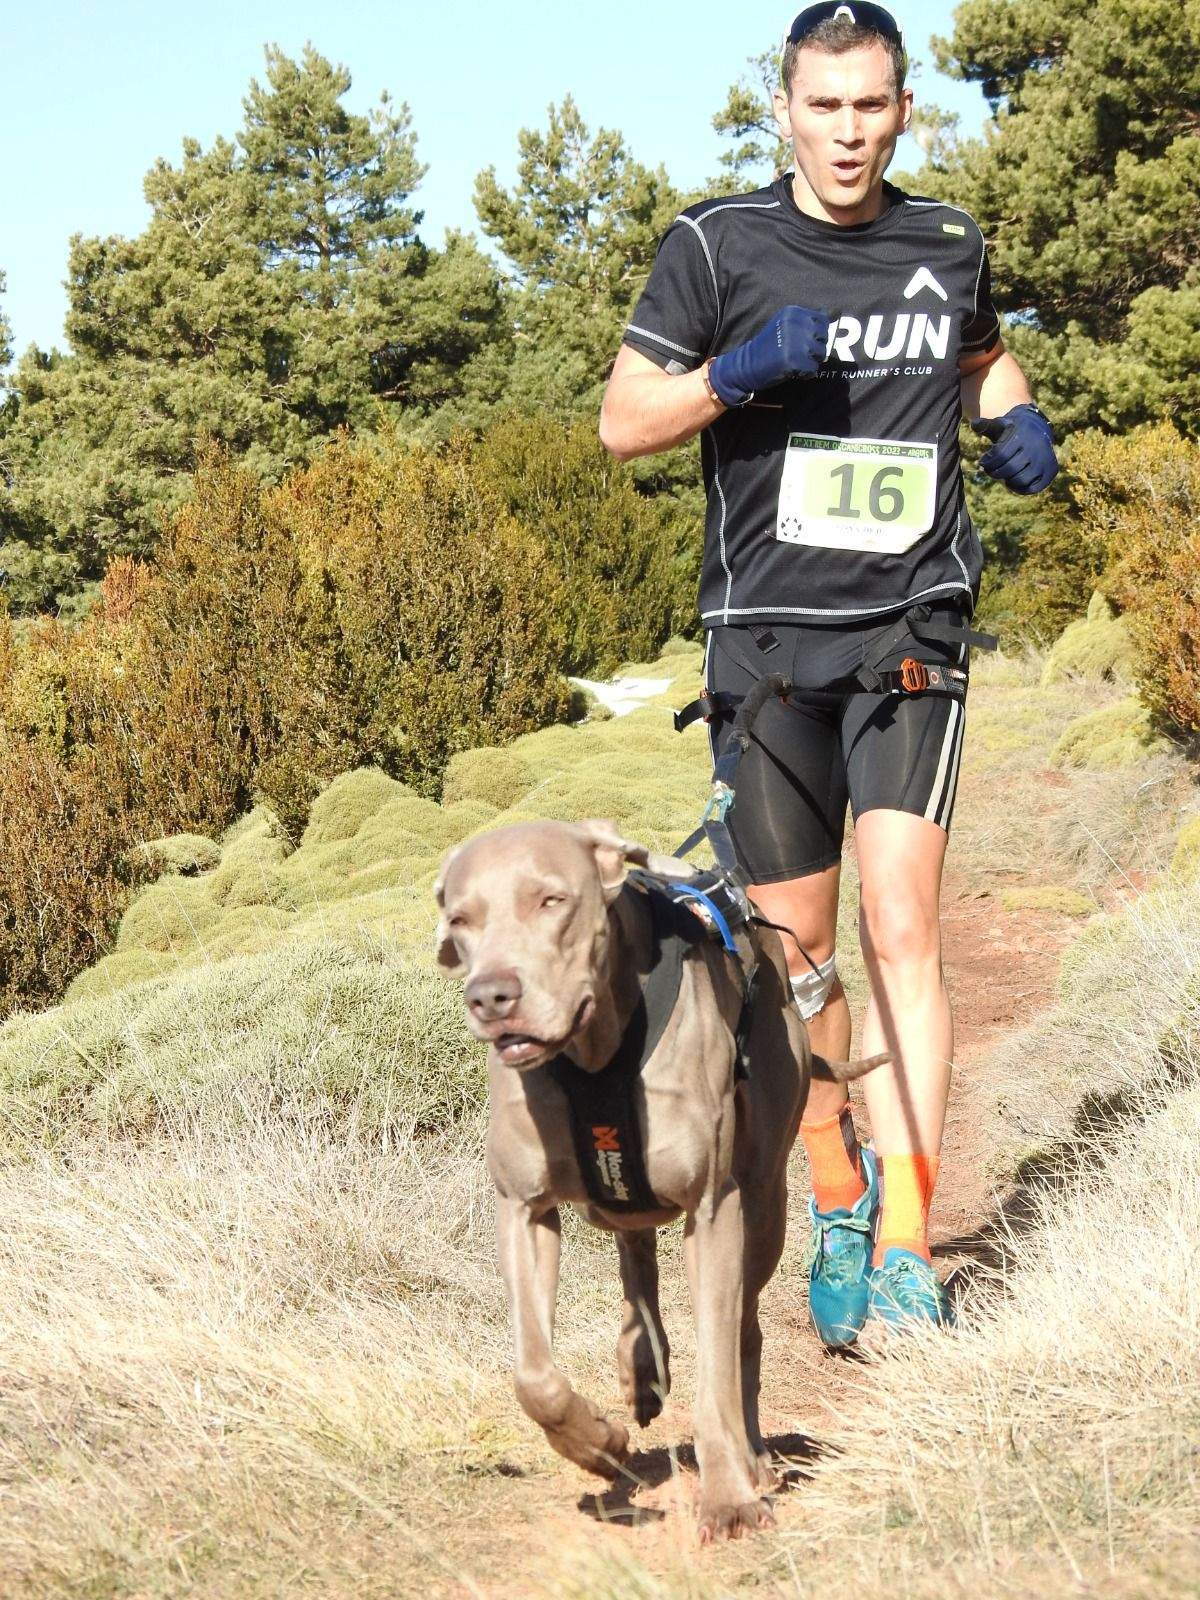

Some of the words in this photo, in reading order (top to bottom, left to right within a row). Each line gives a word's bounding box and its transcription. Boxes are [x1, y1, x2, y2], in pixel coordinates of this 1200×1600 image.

[824, 313, 951, 362] RUN
[841, 367, 900, 379] RUNNER'S
[904, 366, 933, 375] CLUB
[827, 463, 905, 522] 16
